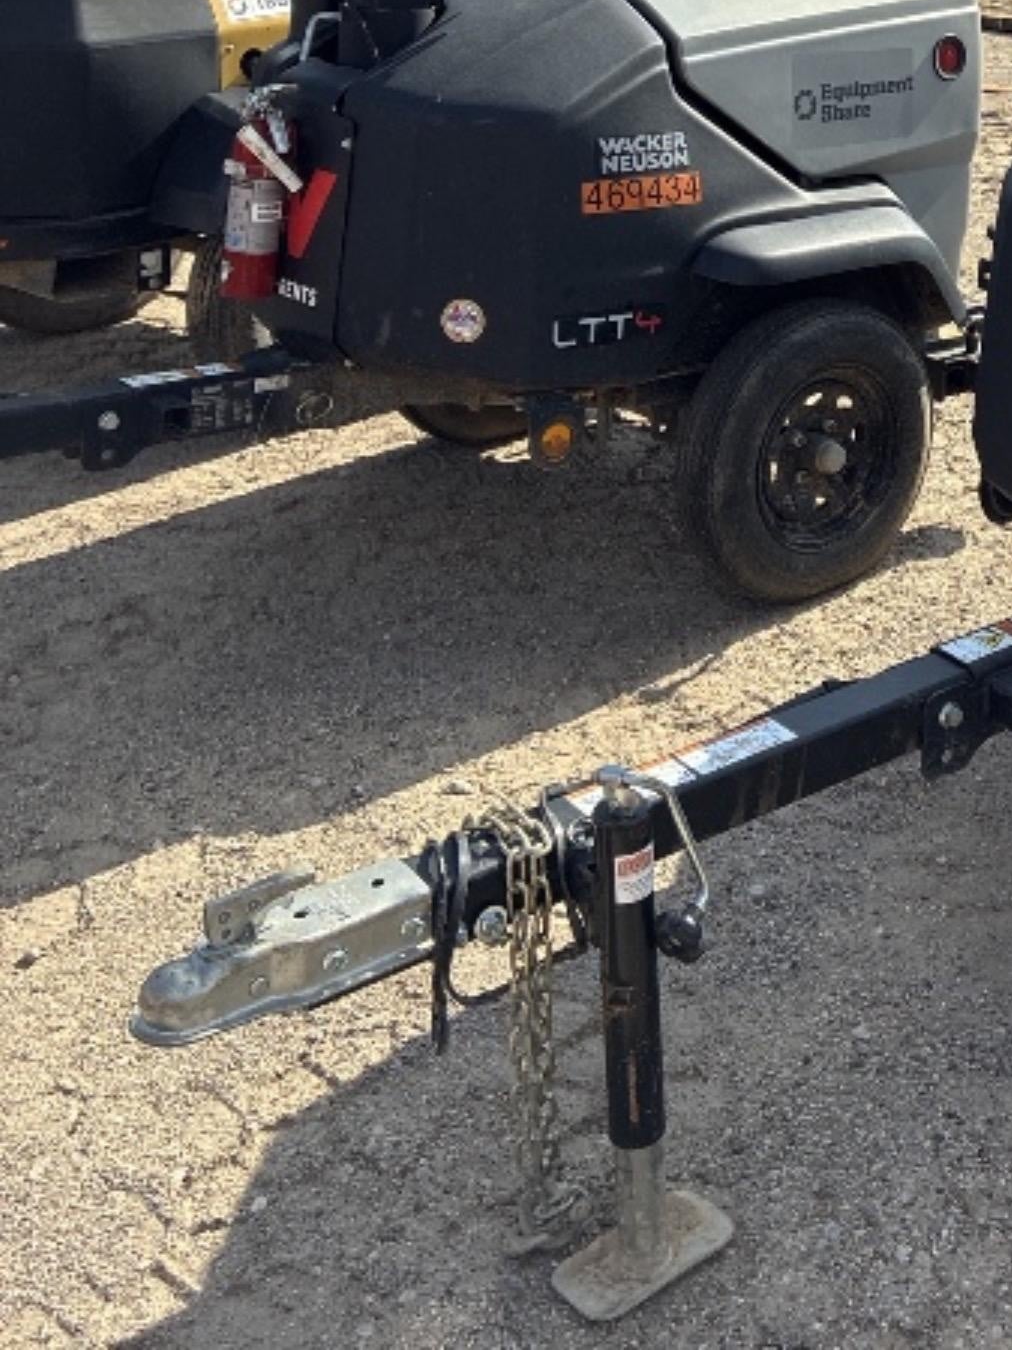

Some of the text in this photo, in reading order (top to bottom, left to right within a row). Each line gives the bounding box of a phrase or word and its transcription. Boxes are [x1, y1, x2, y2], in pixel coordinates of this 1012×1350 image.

[819, 76, 915, 105] Equipment
[819, 100, 872, 123] Share
[600, 131, 688, 154] WACKER
[601, 149, 690, 173] NEUSON
[584, 173, 701, 213] 469434
